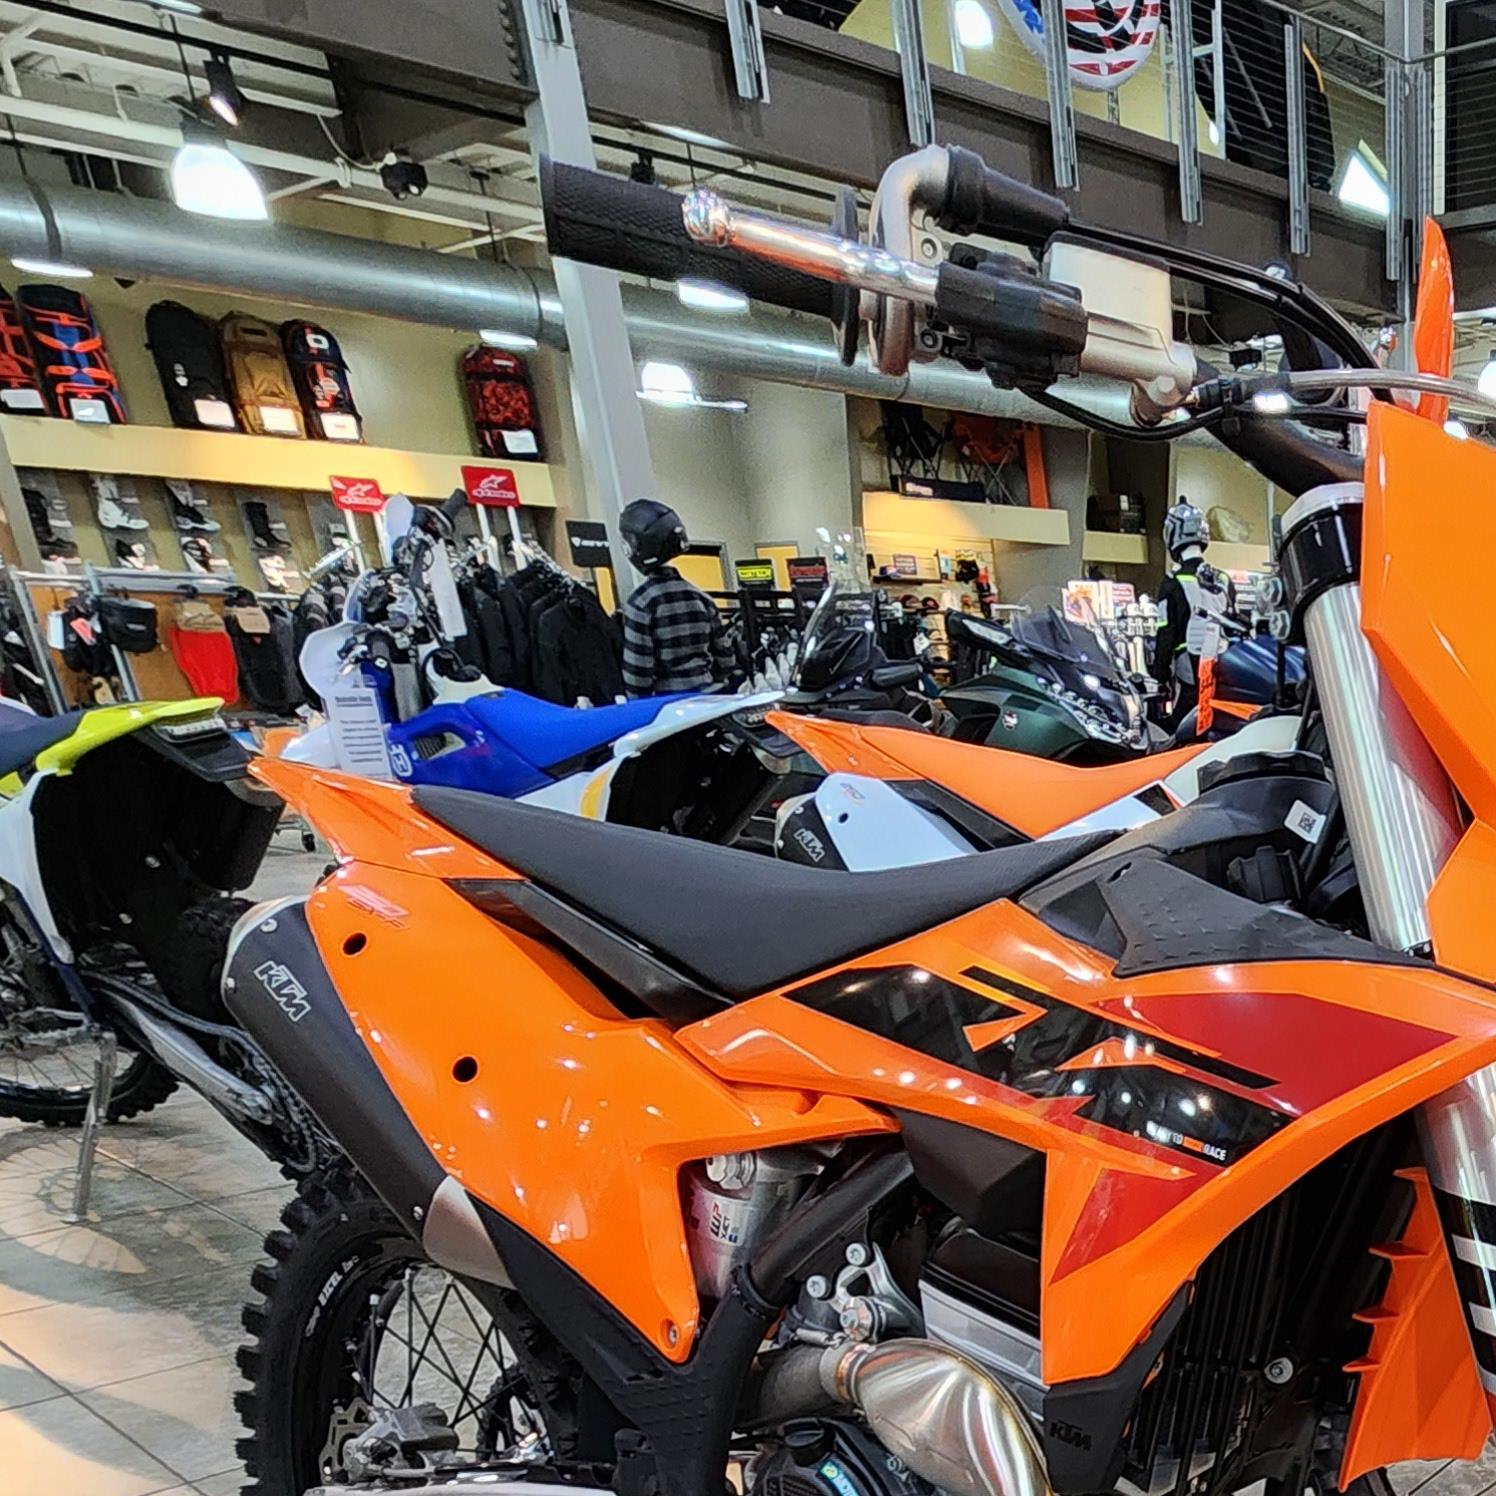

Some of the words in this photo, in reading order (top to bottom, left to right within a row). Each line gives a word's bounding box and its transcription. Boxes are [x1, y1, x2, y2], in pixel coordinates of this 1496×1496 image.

[792, 828, 825, 862] KTM
[253, 960, 312, 1022] KTM
[1203, 1143, 1227, 1161] RACE
[1050, 1420, 1092, 1451] KTM
